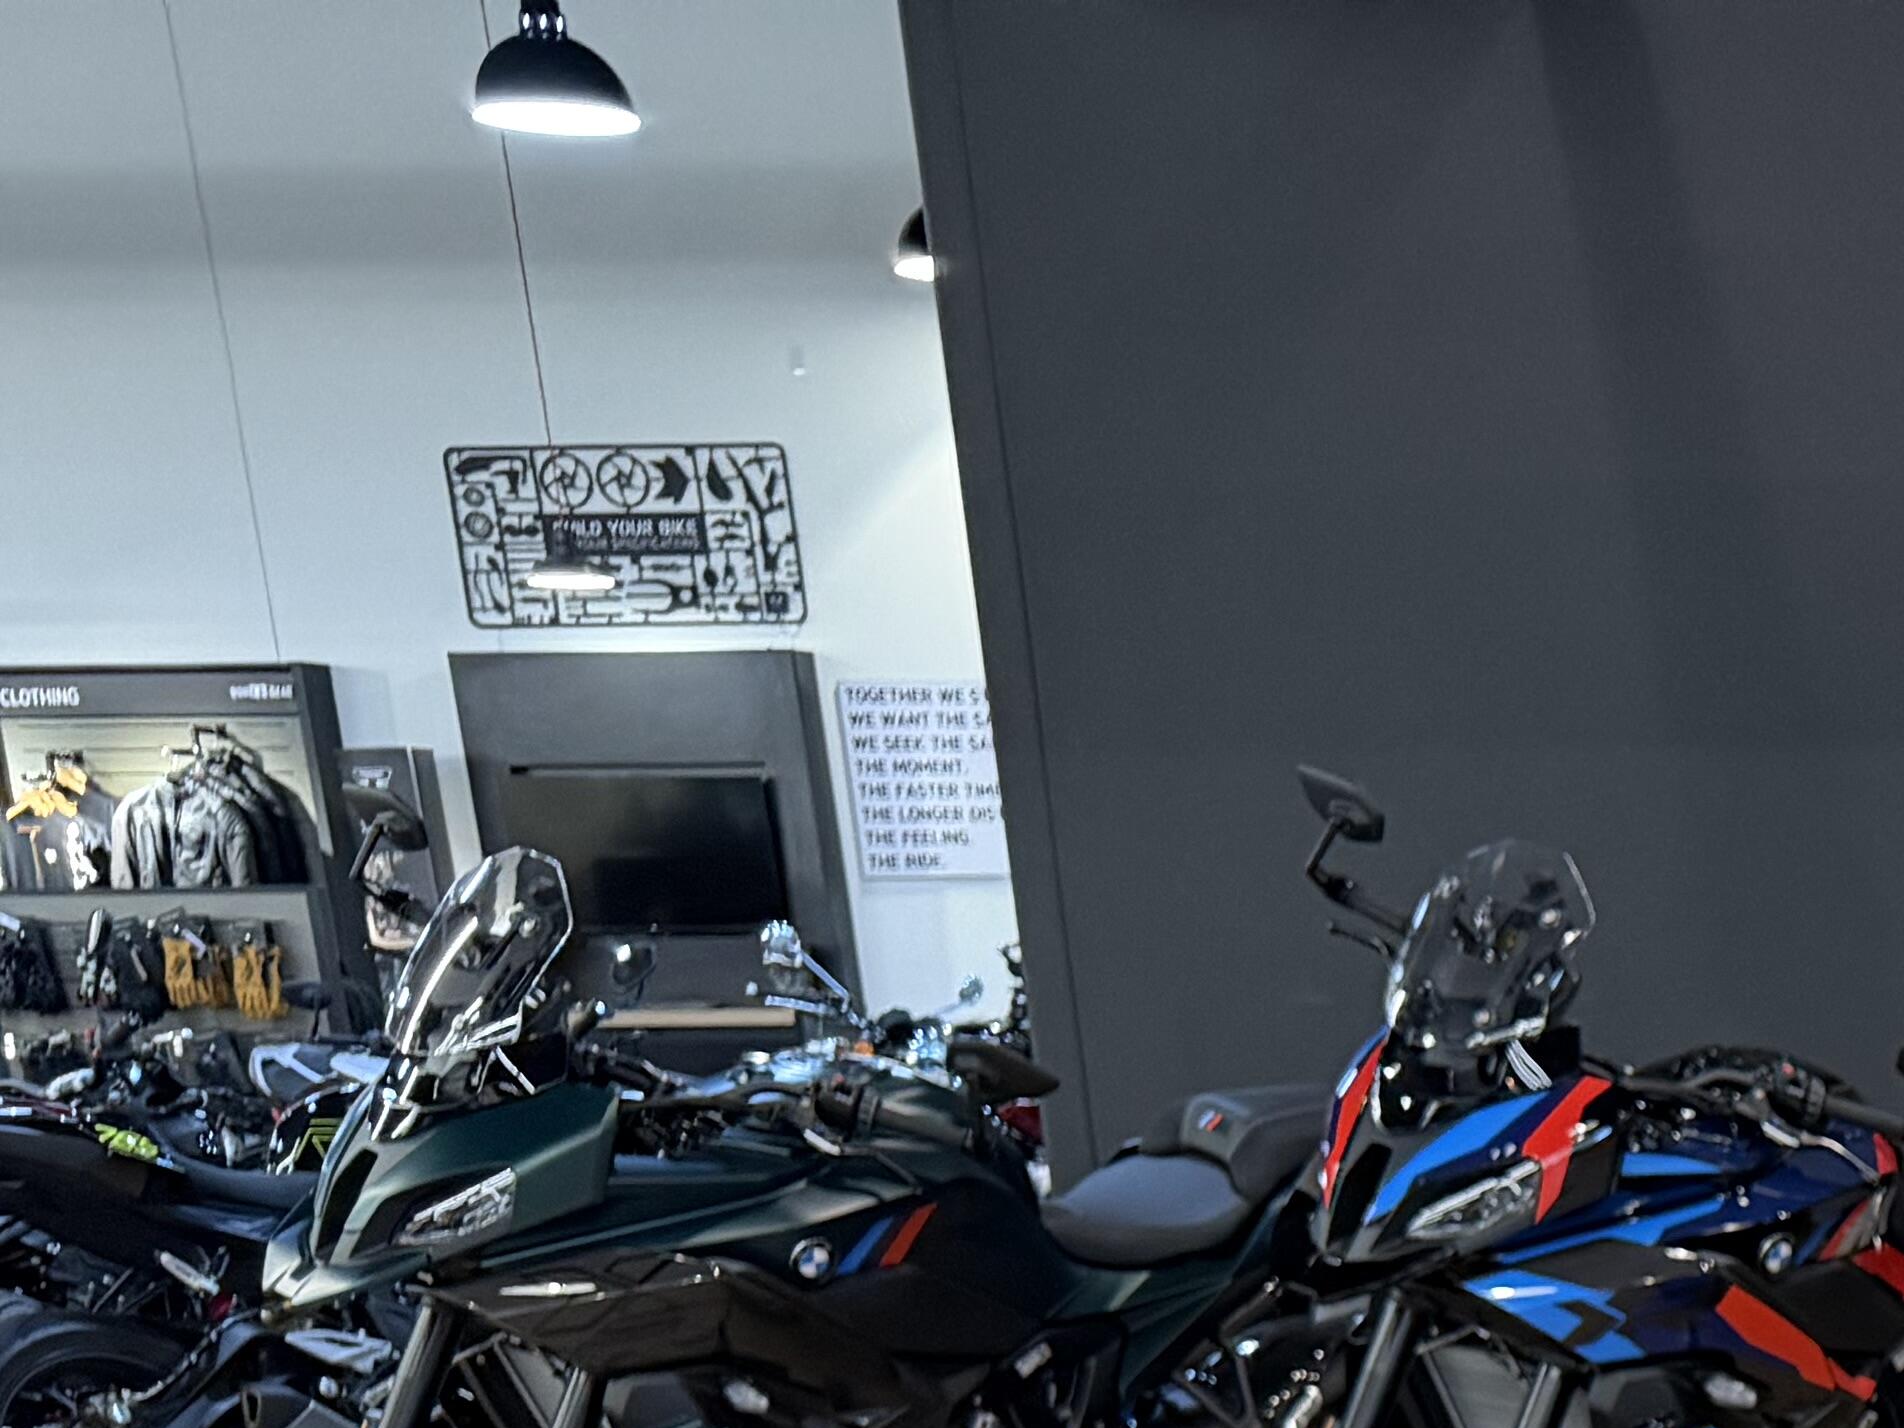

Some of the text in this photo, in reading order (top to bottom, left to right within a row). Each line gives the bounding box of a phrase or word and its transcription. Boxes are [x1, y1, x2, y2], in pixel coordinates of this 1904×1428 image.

[0, 686, 80, 708] CLOTHING
[845, 686, 933, 702] TOGETHER
[938, 687, 967, 701] WE
[849, 712, 877, 727] WE
[880, 711, 930, 726] WANT
[936, 711, 966, 726] THE
[852, 735, 879, 750] WE
[931, 735, 961, 749] THE
[855, 759, 888, 775] THE
[858, 782, 890, 799] THE
[862, 805, 894, 822] THE
[899, 804, 965, 821] LONGER
[864, 830, 896, 846] THE
[867, 853, 899, 869] THE
